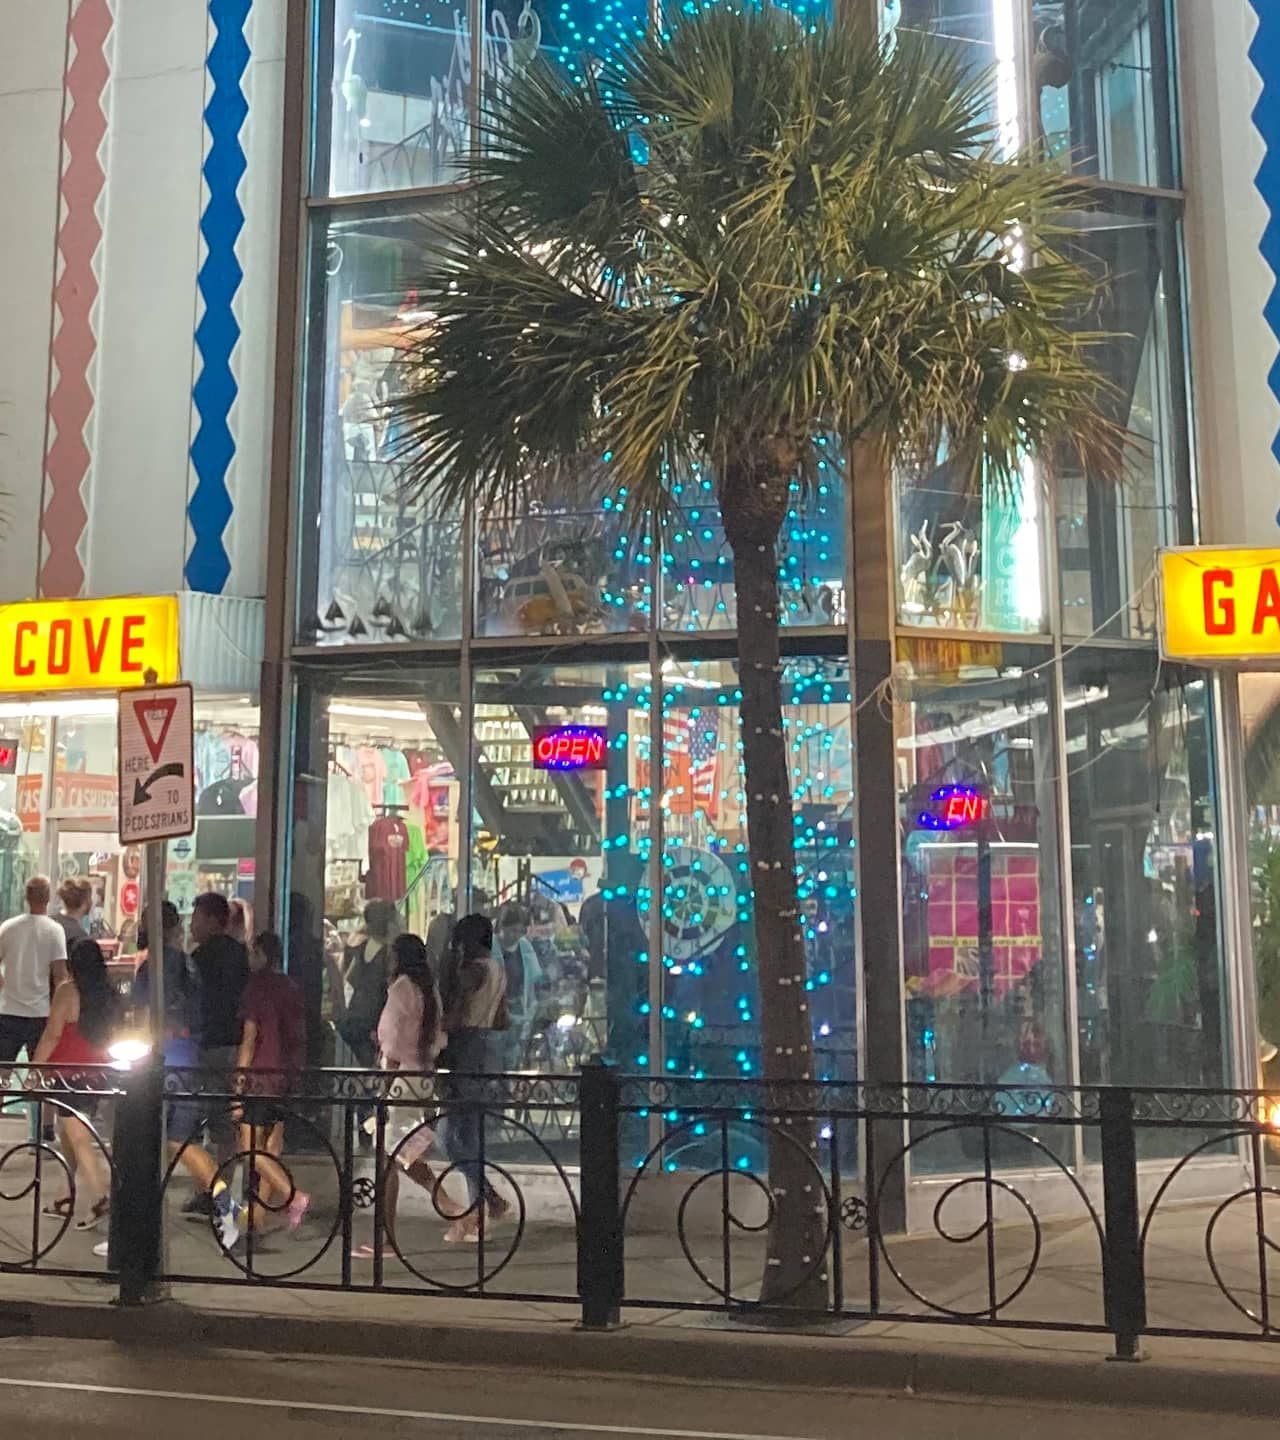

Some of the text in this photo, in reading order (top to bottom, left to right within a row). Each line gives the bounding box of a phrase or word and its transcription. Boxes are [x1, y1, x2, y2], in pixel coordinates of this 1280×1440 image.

[14, 615, 147, 676] COVE
[537, 736, 604, 761] OPEN
[125, 755, 150, 773] HERE
[168, 789, 180, 804] TO
[124, 810, 189, 833] PEDESTRIANS
